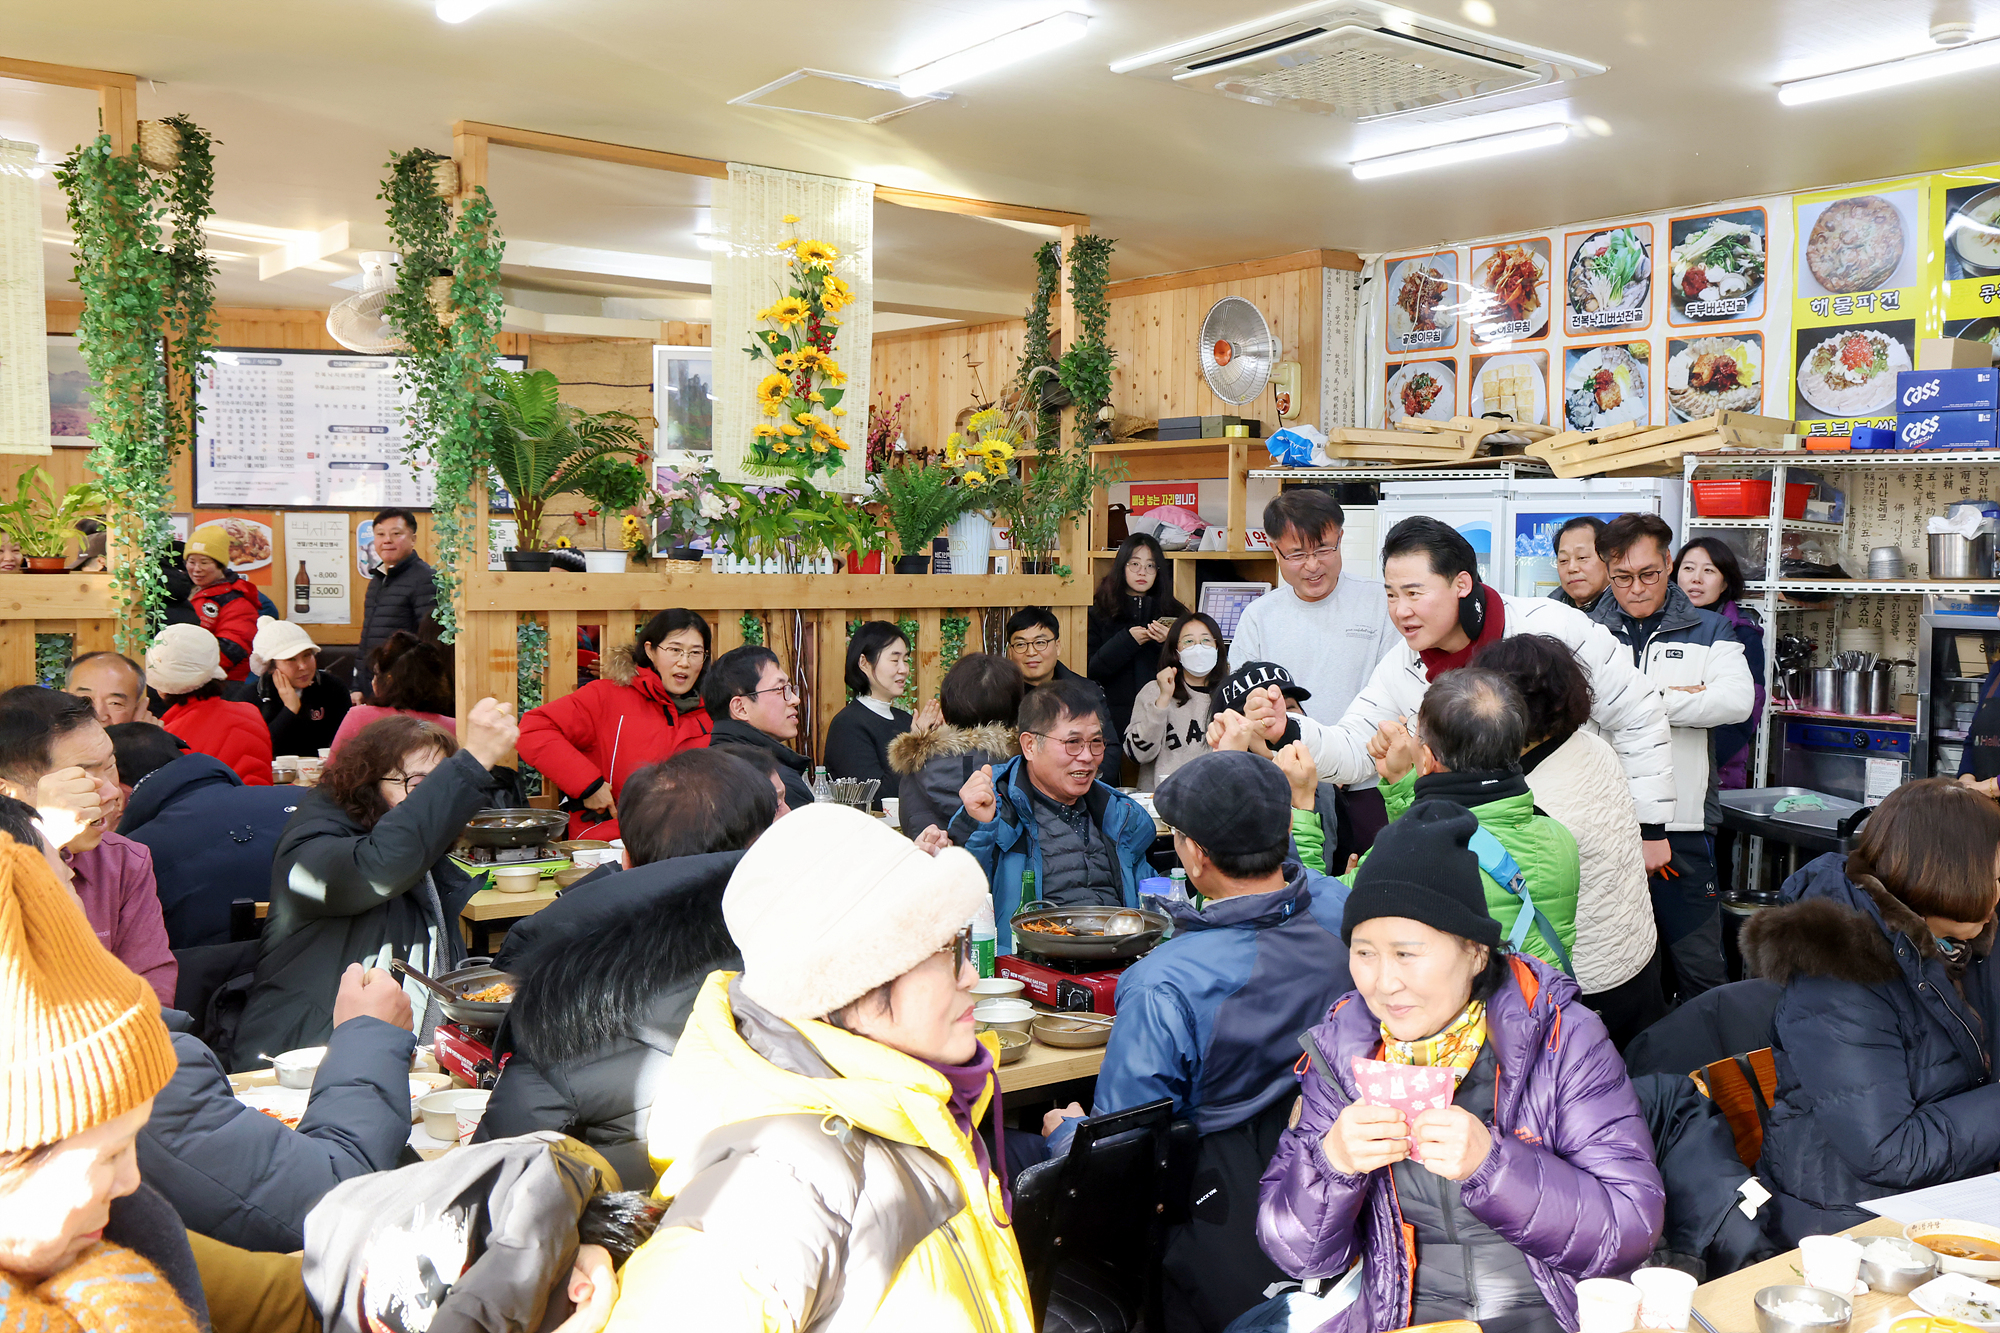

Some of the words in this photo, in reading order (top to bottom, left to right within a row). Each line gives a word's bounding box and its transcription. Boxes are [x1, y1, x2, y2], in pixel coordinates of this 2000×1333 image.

[1980, 284, 2000, 304] 콩
[1686, 298, 1747, 317] 두부버섯전골
[1810, 290, 1900, 318] 해물파전
[1572, 310, 1644, 327] 전복낙지버섯전골
[1403, 331, 1440, 345] 골뱅이무침
[1146, 494, 1160, 506] 놓는
[1161, 493, 1196, 506] 자리입니다
